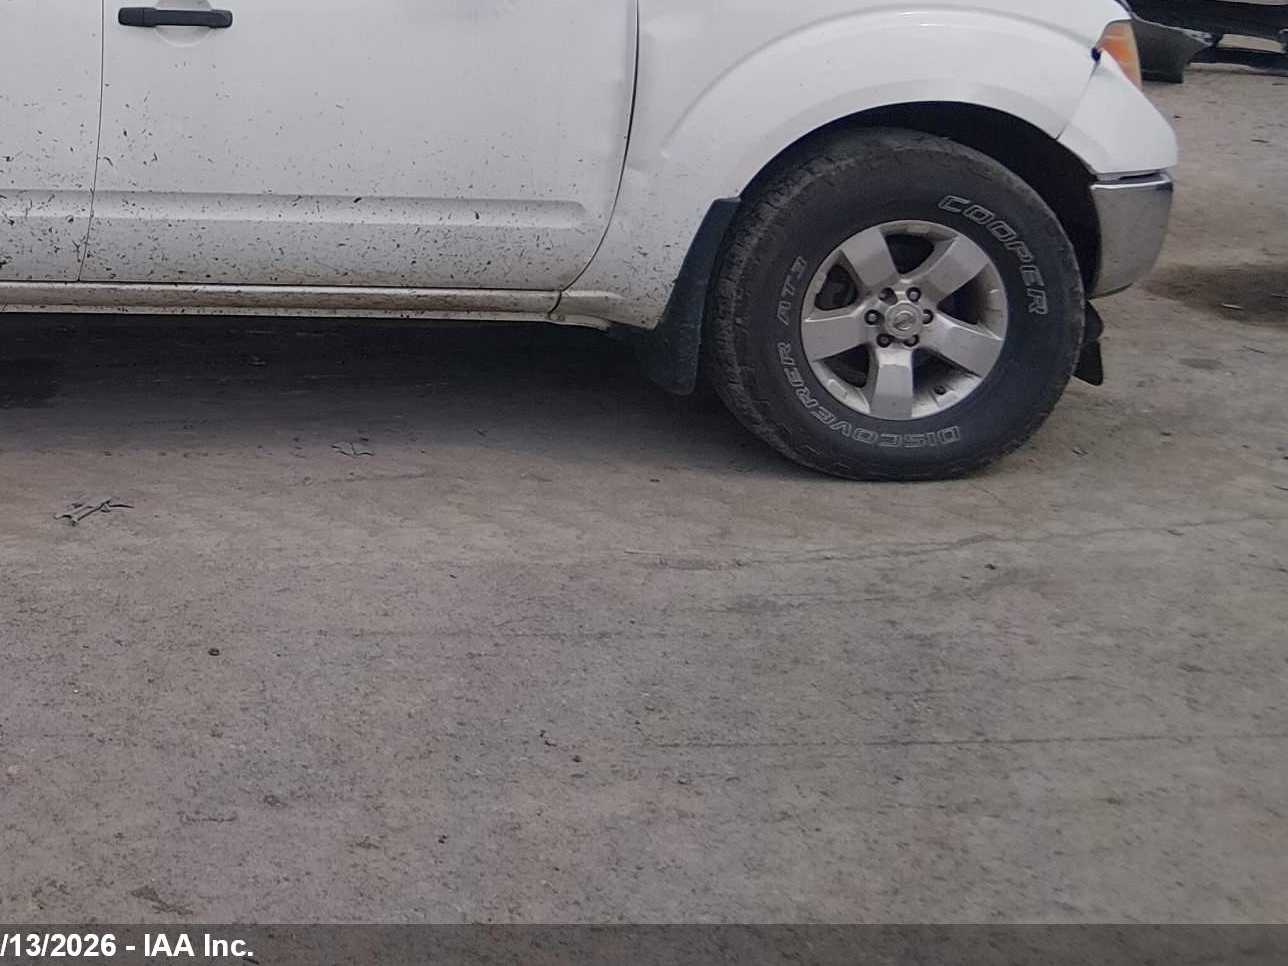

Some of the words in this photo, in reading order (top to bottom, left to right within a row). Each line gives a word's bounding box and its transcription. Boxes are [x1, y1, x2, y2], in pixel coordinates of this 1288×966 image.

[777, 255, 807, 326] AT3
[937, 194, 1049, 316] COOPER
[777, 341, 962, 449] DISCOVERER
